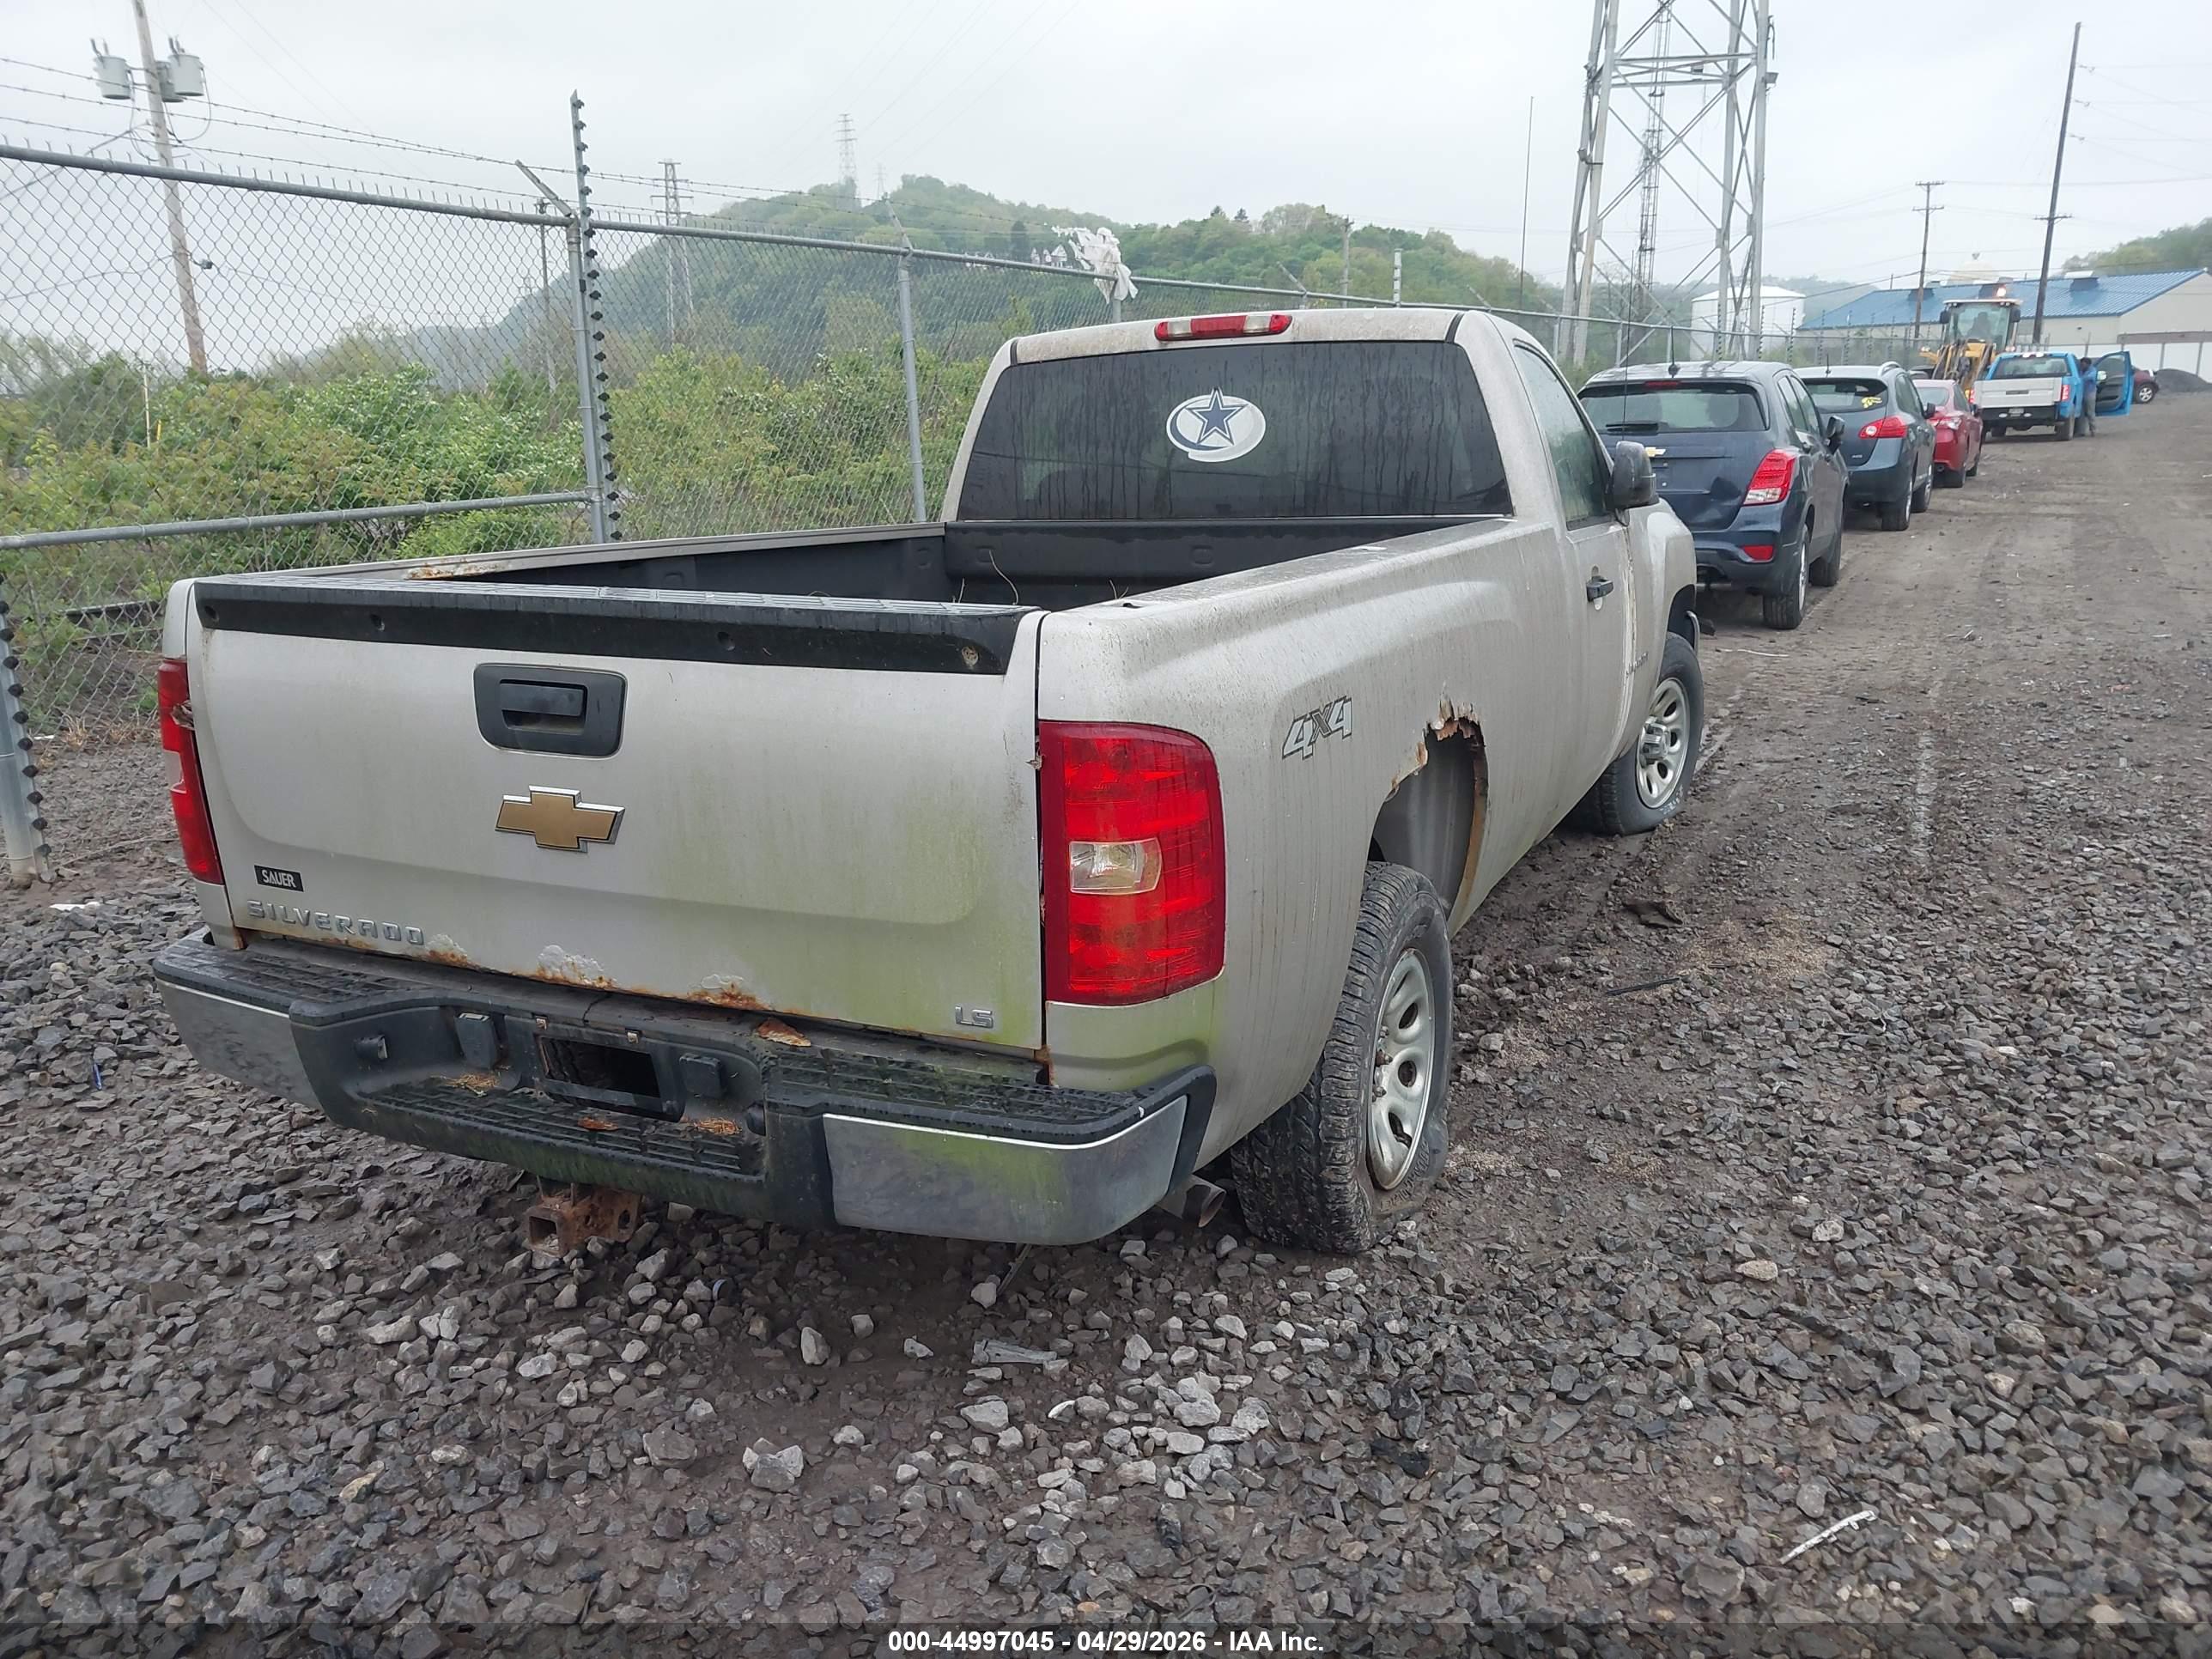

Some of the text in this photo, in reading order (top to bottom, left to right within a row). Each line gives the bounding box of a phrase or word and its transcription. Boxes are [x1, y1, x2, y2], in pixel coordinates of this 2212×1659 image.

[261, 869, 297, 888] SAUER
[246, 900, 425, 945] SILVERADO
[955, 1006, 994, 1029] LS
